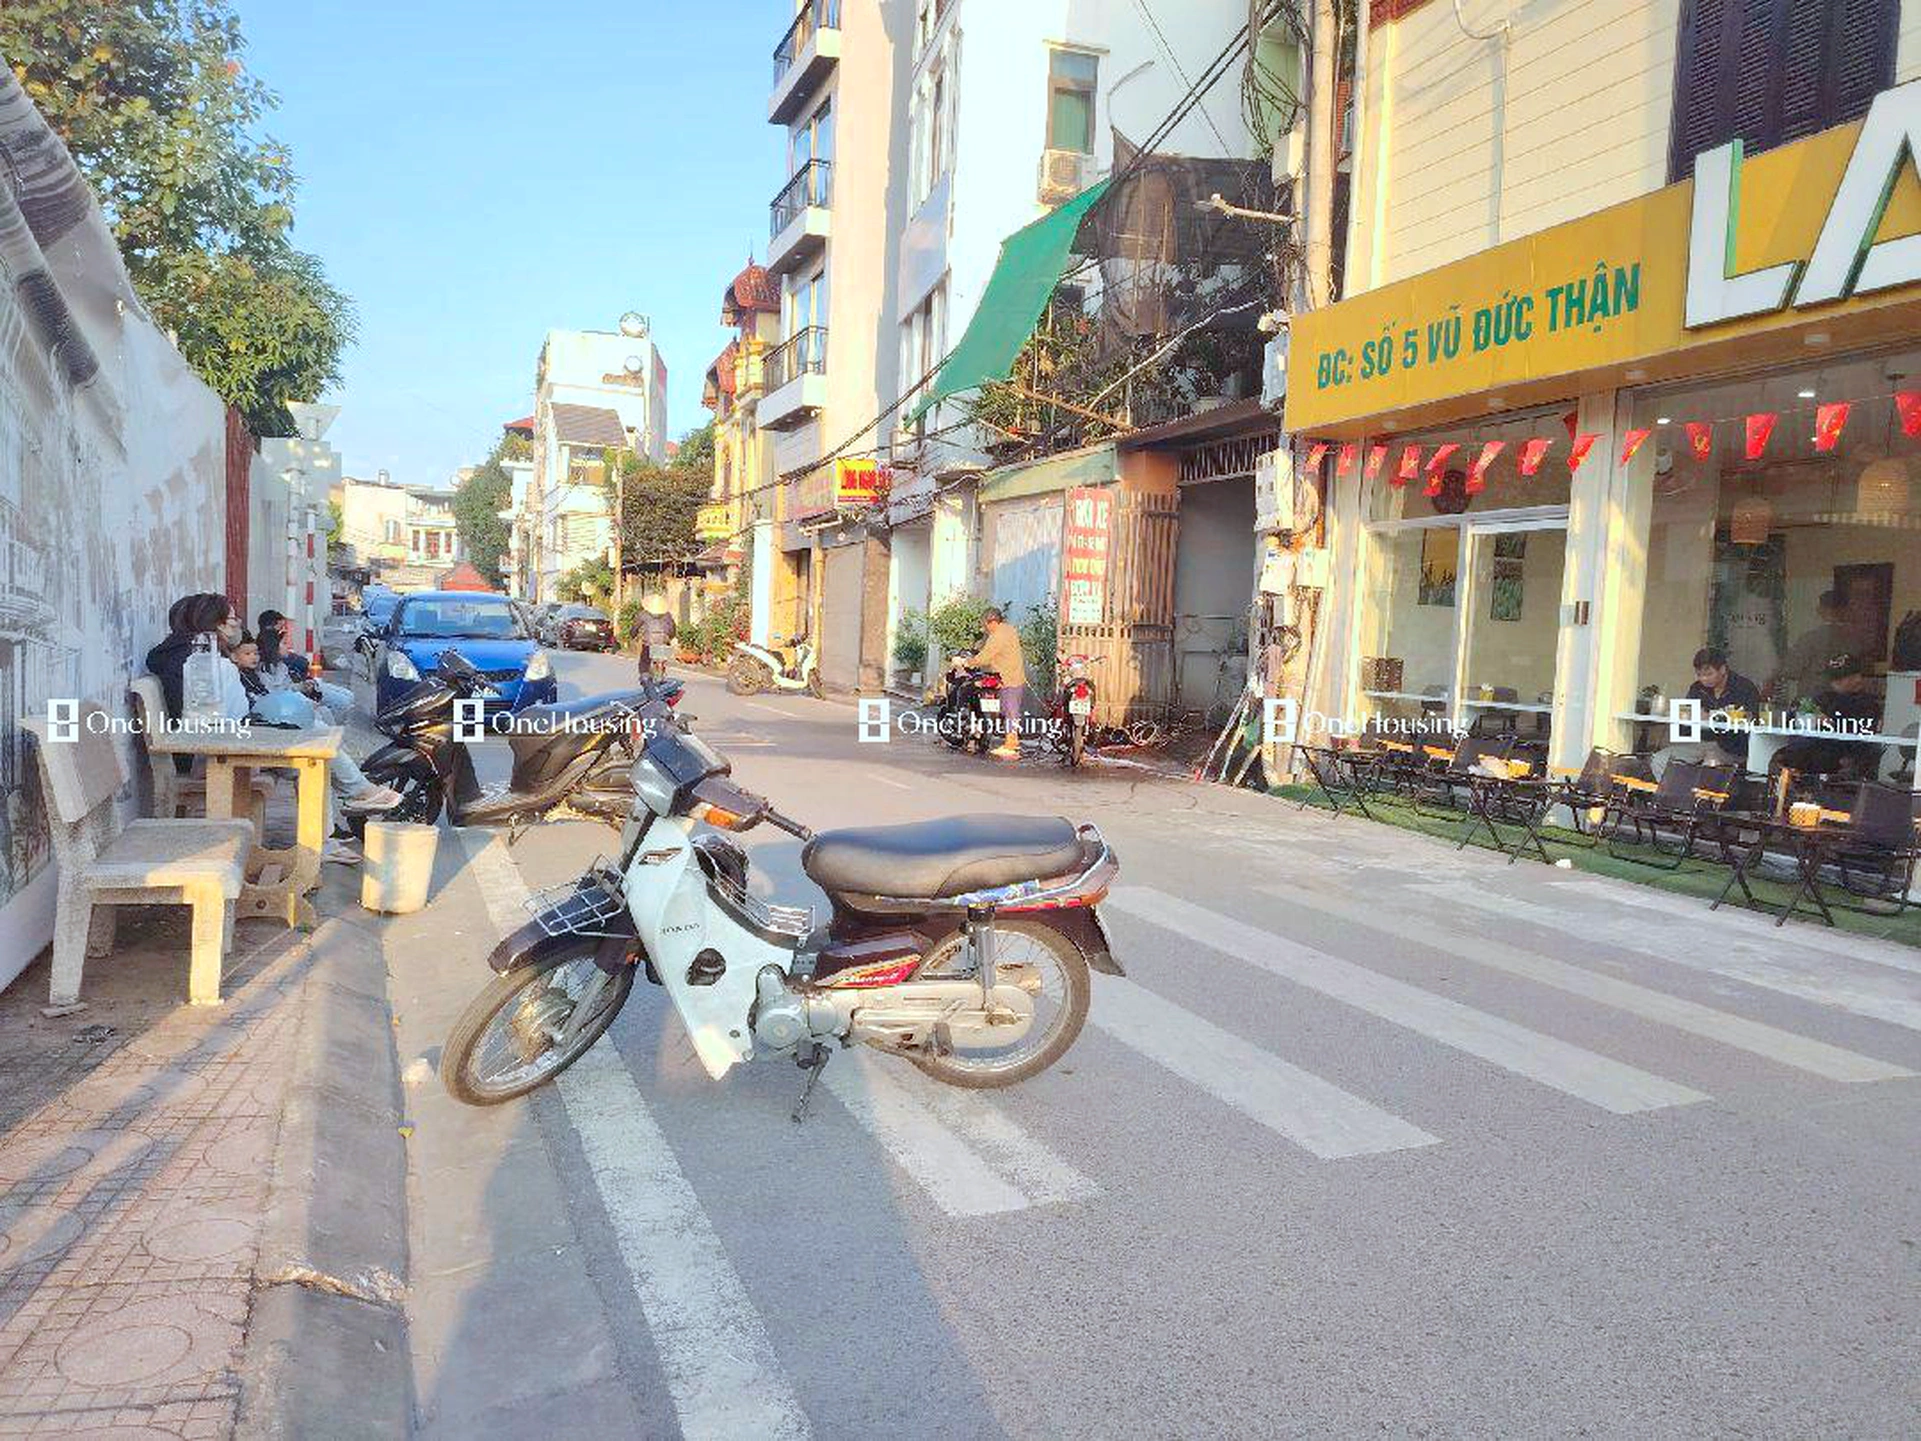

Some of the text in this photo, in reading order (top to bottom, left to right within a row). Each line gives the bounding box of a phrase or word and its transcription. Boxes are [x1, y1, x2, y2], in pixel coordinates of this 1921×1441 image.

[1360, 321, 1396, 380] SỐ
[1402, 329, 1418, 369] 5
[1427, 305, 1462, 364] VŨ
[1472, 290, 1534, 352] ĐỨC
[1546, 261, 1641, 333] THẬN
